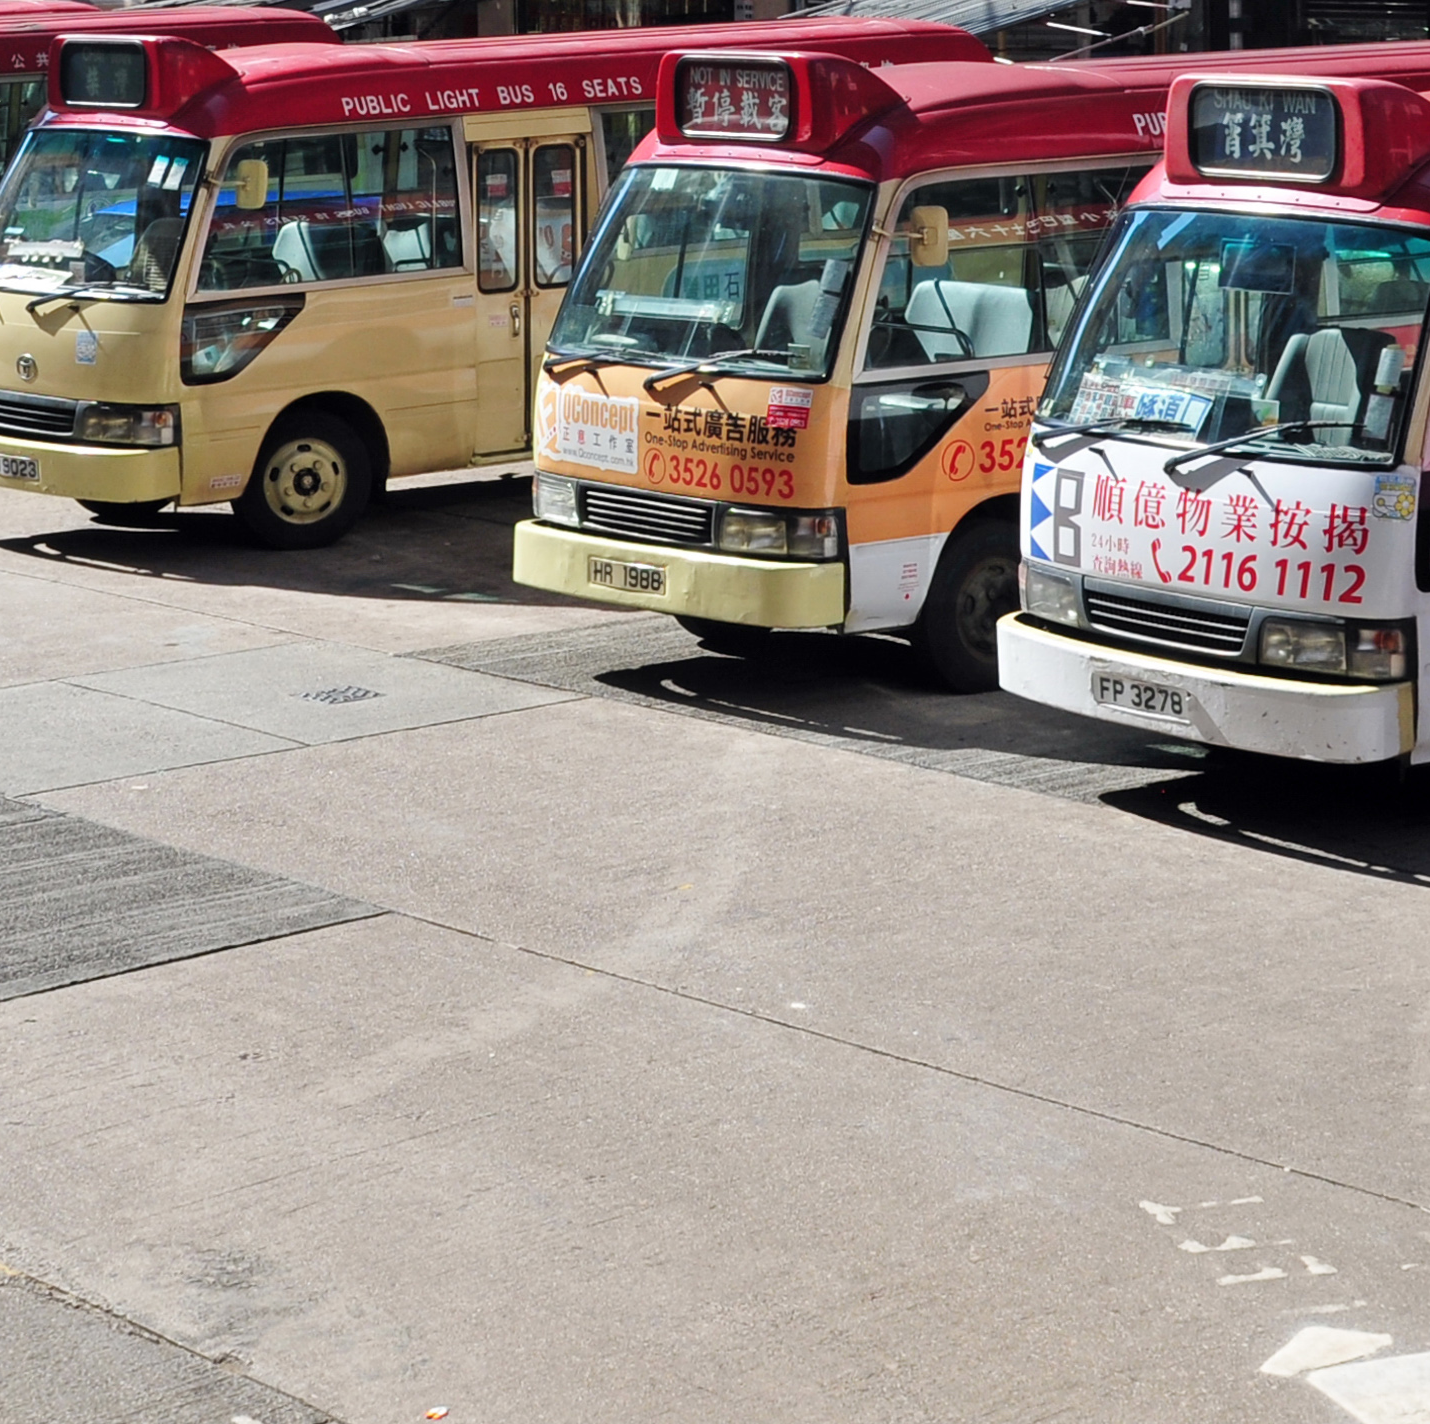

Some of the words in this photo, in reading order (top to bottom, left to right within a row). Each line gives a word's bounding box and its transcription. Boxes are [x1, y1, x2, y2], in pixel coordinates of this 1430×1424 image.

[342, 93, 411, 116] PUBLIC
[426, 88, 480, 111] LIGHT
[497, 84, 535, 105] BUS
[548, 82, 568, 101] 16
[582, 77, 643, 99] SEATS
[690, 67, 714, 85] NOT
[719, 69, 731, 86] IN
[736, 70, 784, 91] SERVICE
[686, 87, 789, 132] 暫停載客
[1213, 89, 1251, 110] SHAU
[1282, 93, 1317, 114] WAN
[1222, 112, 1306, 164] 筲箕灣
[563, 392, 636, 434] QConcept
[646, 403, 797, 448] 一站式廣告服務
[984, 420, 1024, 432] One-Stop
[562, 426, 634, 454] 正意工作室
[644, 431, 689, 451] One-Stop
[691, 437, 747, 460] Advertising
[750, 445, 795, 463] Service
[669, 455, 722, 490] 3526
[730, 464, 795, 500] 0593
[1092, 473, 1370, 555] 順億物業按揭
[1091, 533, 1130, 555] 24小時
[593, 562, 613, 584] HR
[622, 565, 662, 591] 1988
[1092, 555, 1143, 580] 查詢熱線
[1177, 545, 1258, 592] 2116
[1274, 558, 1367, 604] 1112
[1100, 677, 1125, 702] FP
[1131, 683, 1183, 715] 3278
